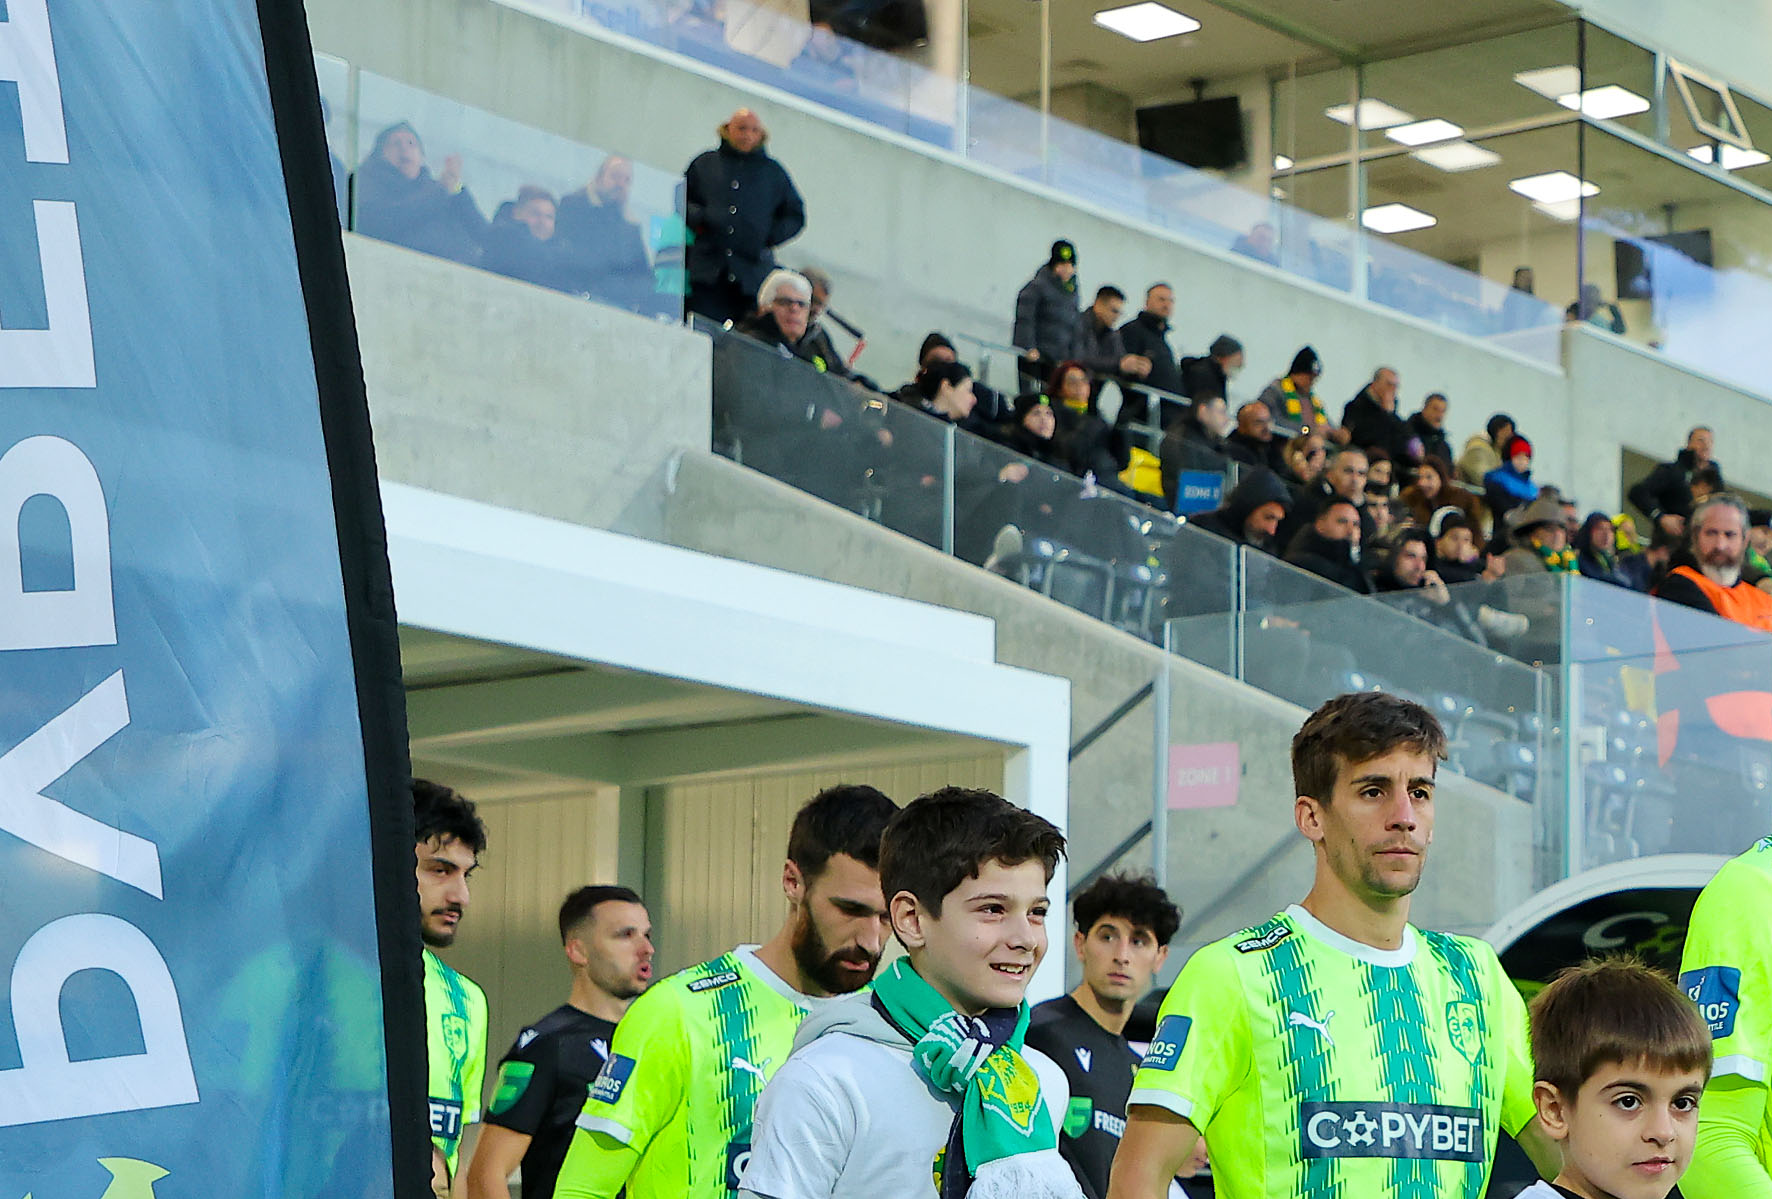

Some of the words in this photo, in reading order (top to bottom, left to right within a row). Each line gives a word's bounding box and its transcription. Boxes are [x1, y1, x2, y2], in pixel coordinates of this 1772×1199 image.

[1237, 926, 1289, 951] ZEMCO
[691, 971, 738, 991] ZEMCO
[1306, 1108, 1480, 1154] COPYBET
